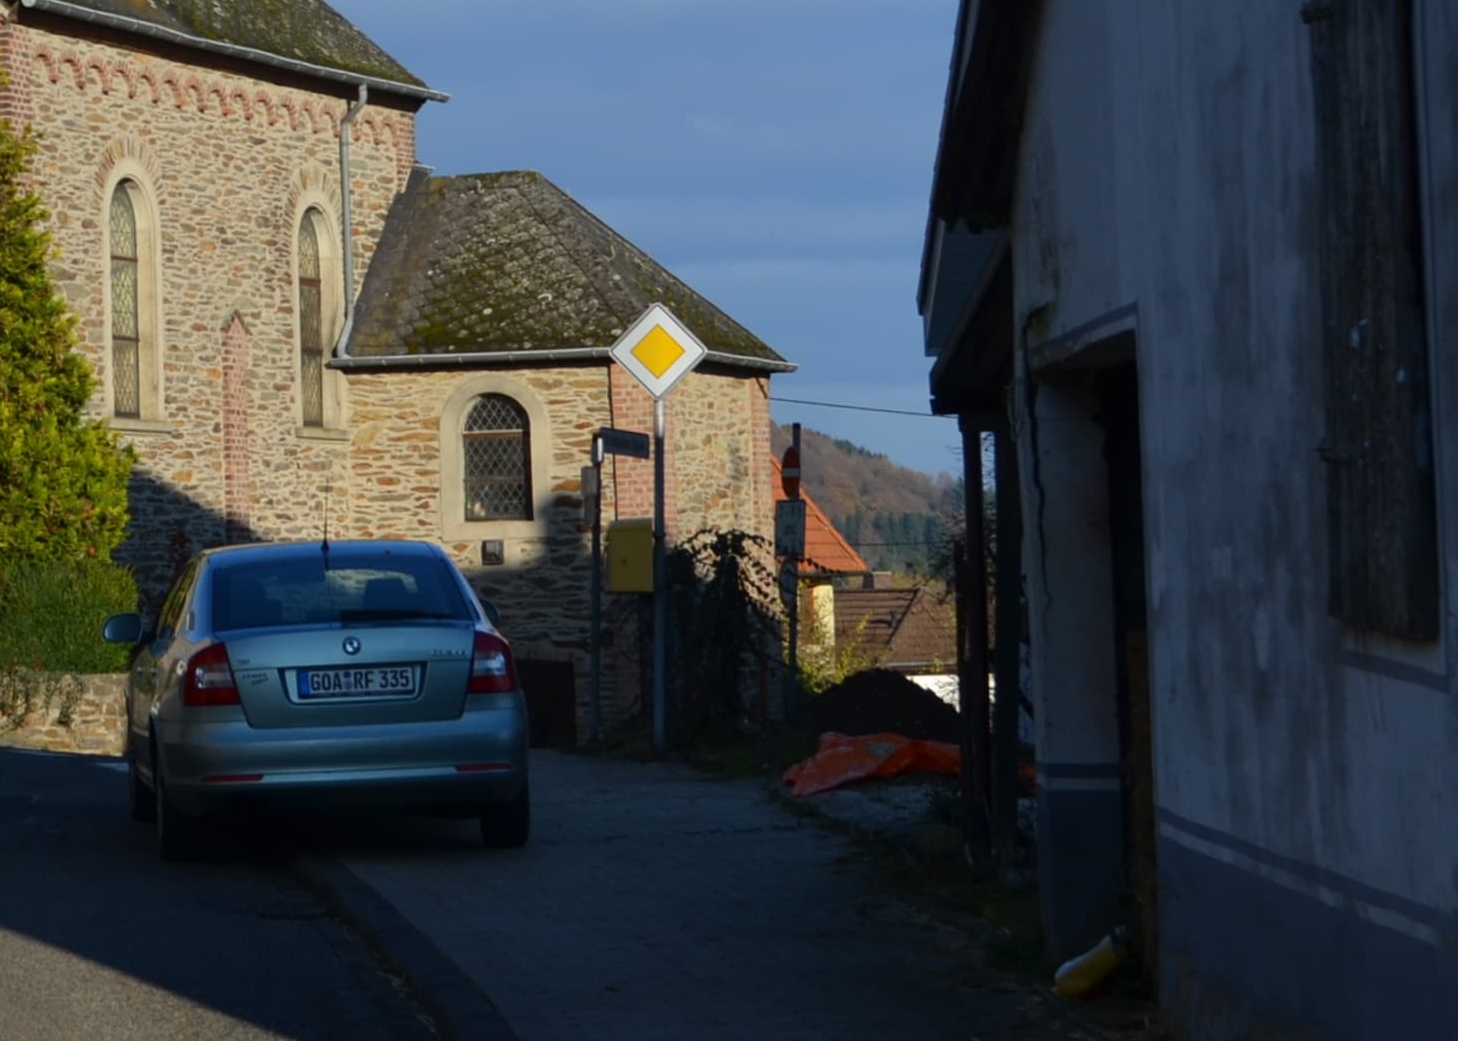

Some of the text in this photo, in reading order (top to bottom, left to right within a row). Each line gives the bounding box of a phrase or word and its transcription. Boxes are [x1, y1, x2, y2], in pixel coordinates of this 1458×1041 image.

[310, 669, 411, 692] GOA RF 335
